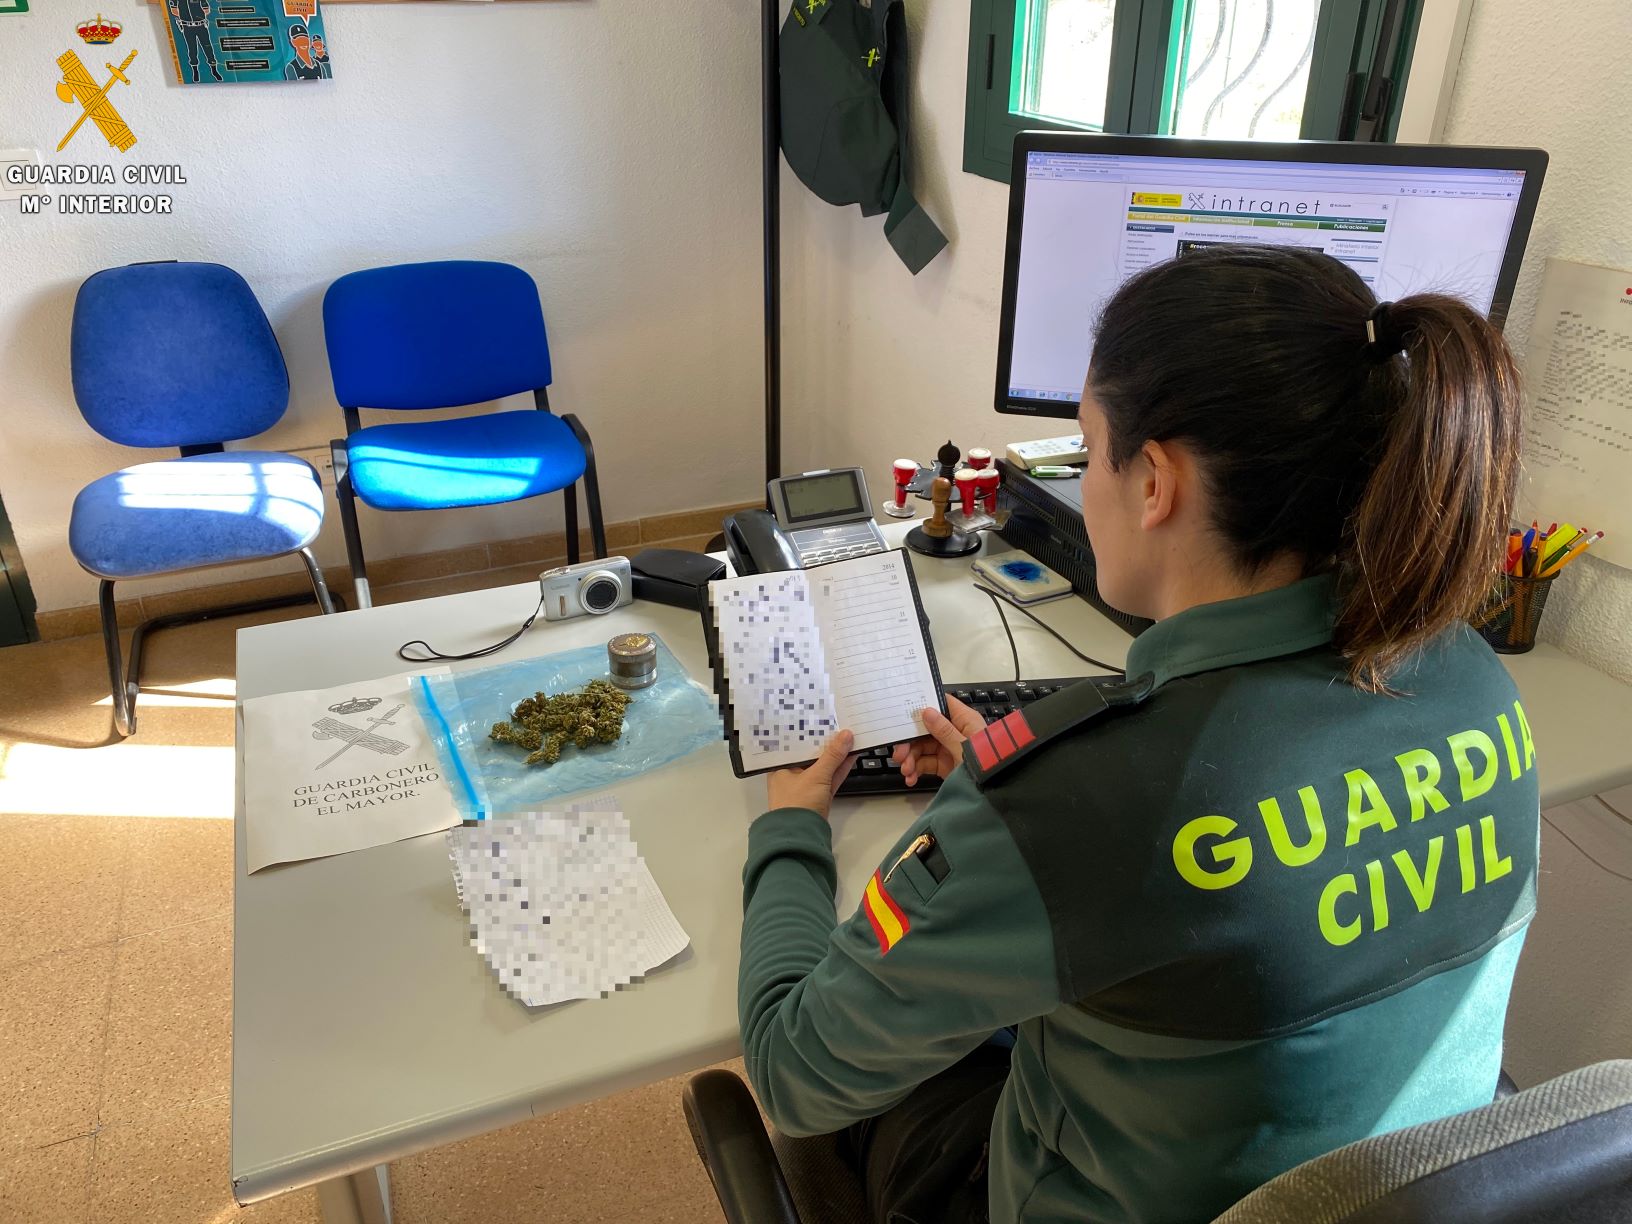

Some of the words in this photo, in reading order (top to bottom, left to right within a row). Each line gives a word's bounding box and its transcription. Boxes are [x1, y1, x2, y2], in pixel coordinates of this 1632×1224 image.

[1212, 194, 1321, 215] intranet
[1333, 223, 1369, 231] Publicaciones
[293, 796, 319, 808] DE
[323, 773, 440, 803] CARBONERO
[294, 774, 381, 796] GUARDIA
[386, 763, 435, 779] CIVIL
[1172, 700, 1537, 890] GUARDIA
[317, 805, 341, 816] EL
[345, 789, 421, 812] MAYOR.
[1318, 814, 1513, 946] CIVIL
